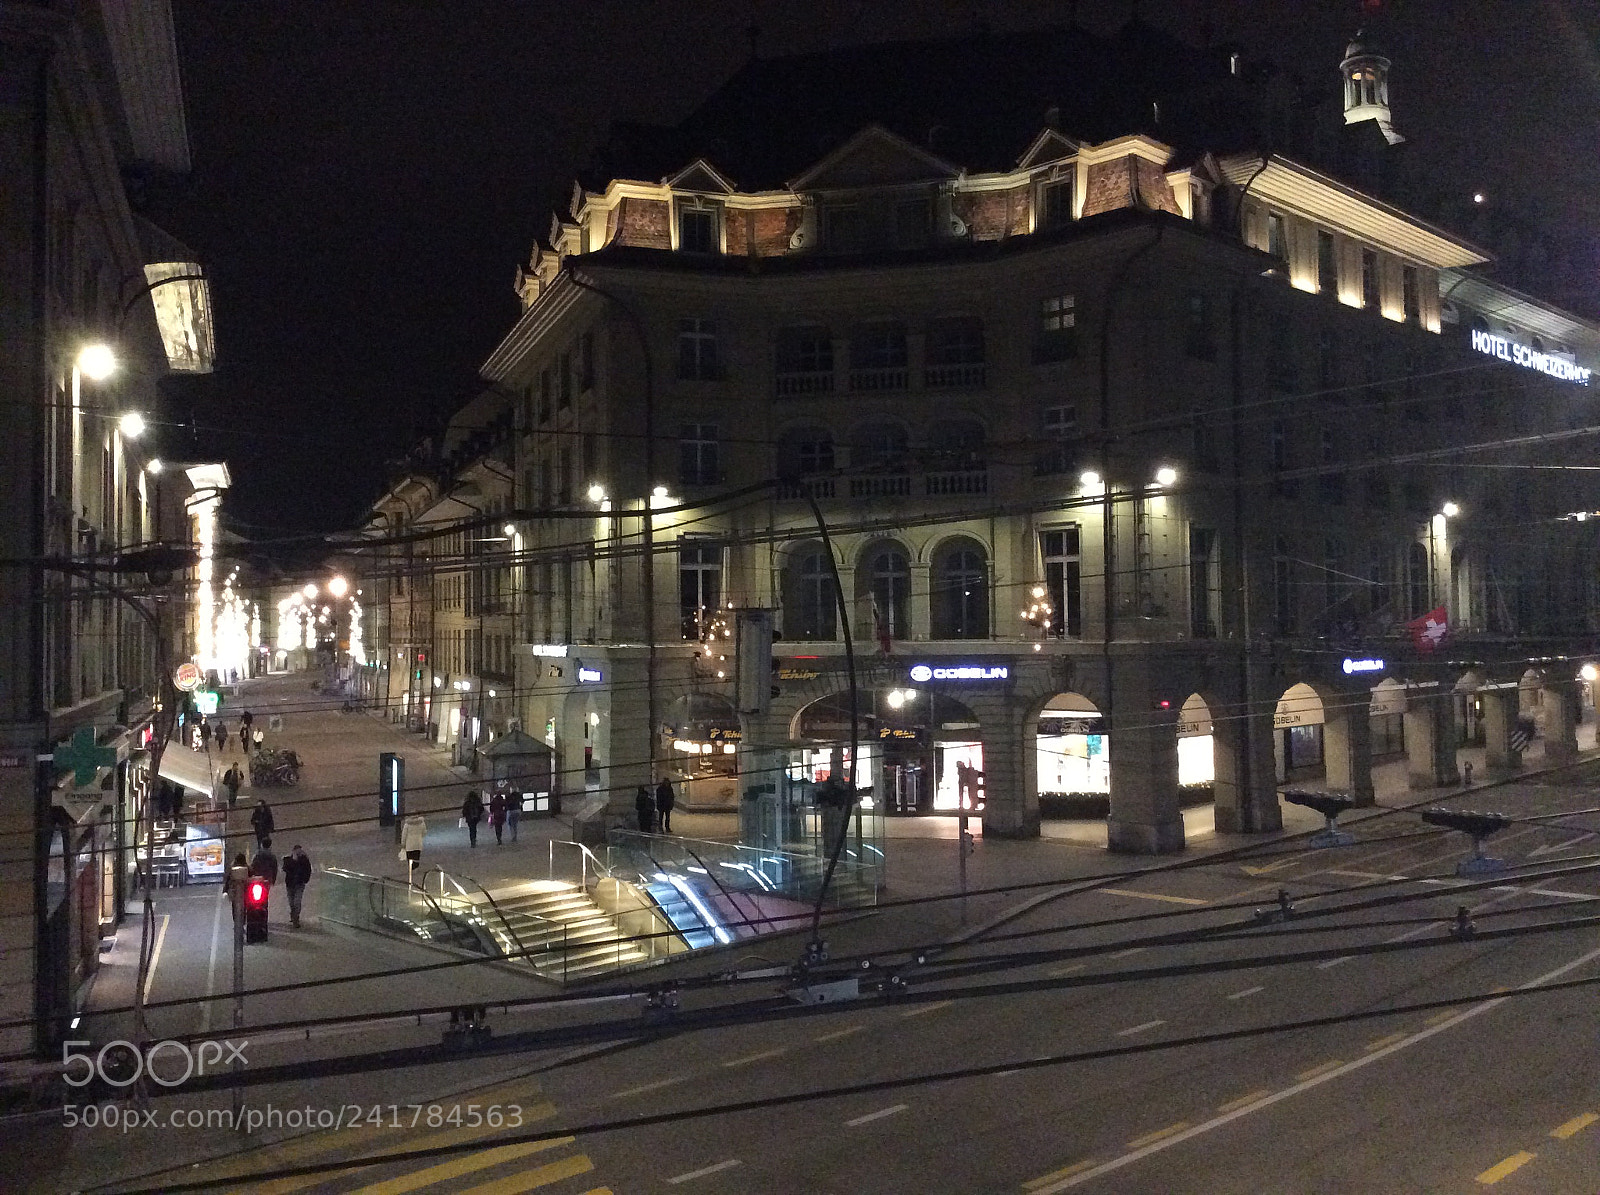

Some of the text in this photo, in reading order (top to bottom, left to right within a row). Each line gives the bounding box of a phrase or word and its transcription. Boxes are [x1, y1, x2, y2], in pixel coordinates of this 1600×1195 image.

[1471, 329, 1512, 362] HOTEL
[179, 672, 197, 682] KING
[1273, 715, 1301, 725] OBELIN
[1176, 723, 1199, 733] BELIN
